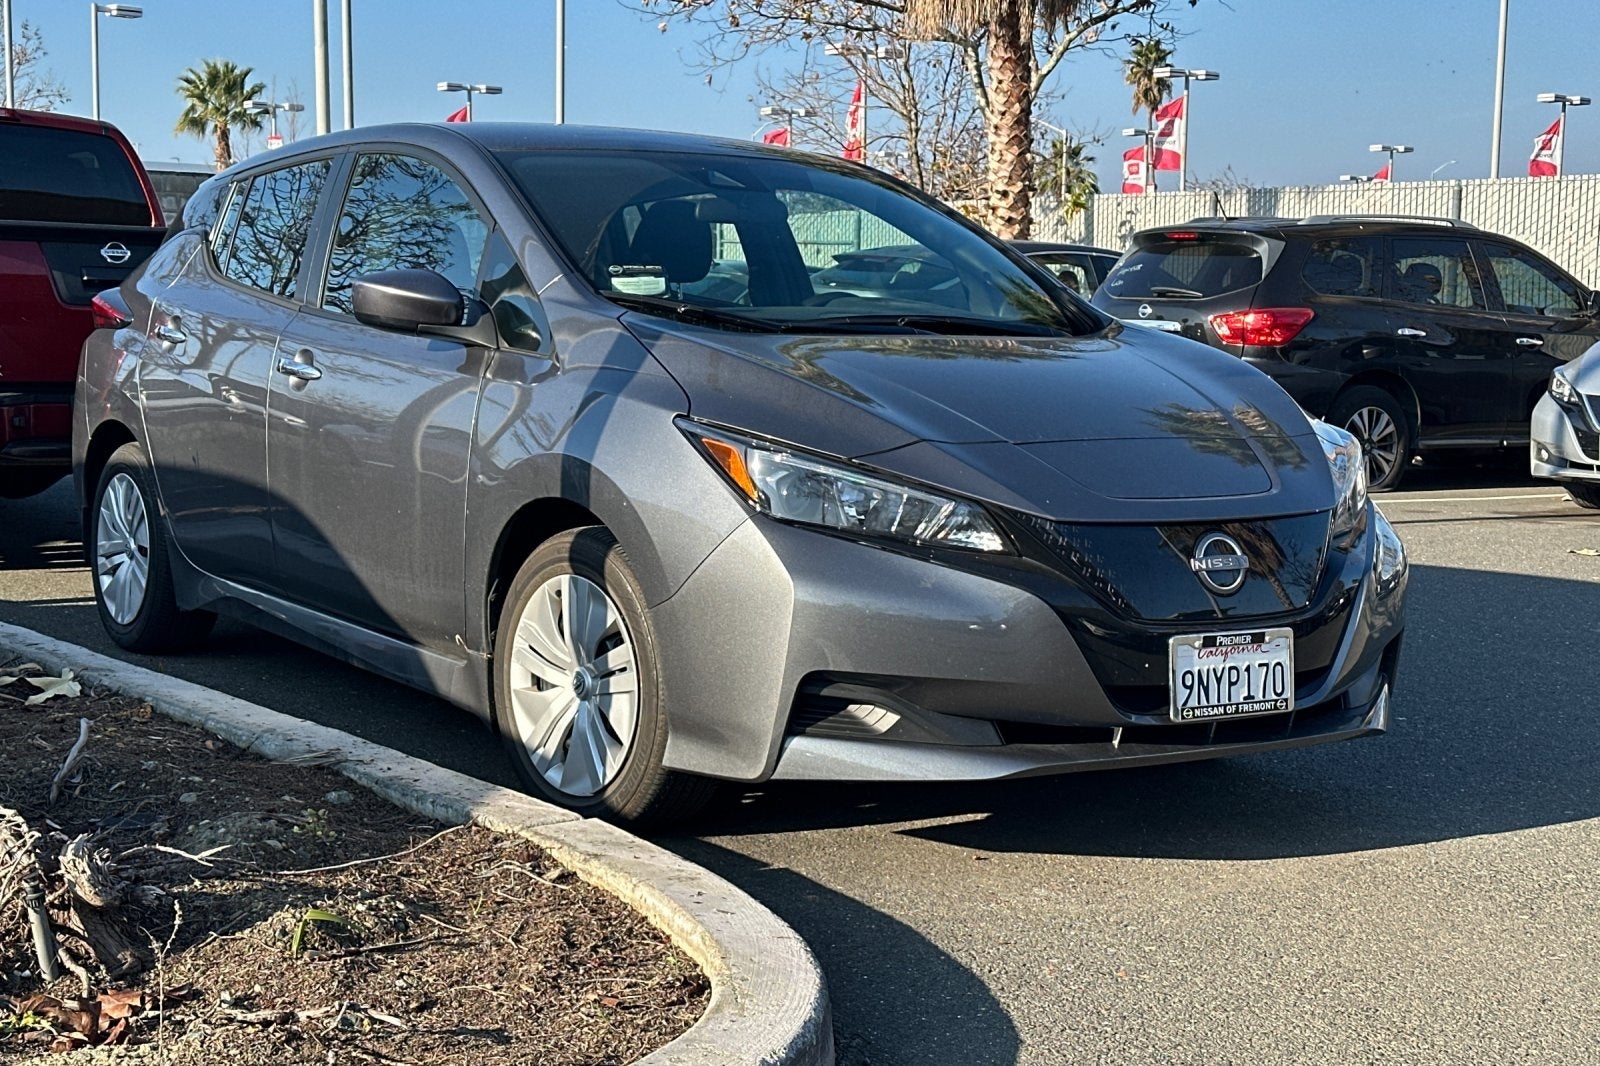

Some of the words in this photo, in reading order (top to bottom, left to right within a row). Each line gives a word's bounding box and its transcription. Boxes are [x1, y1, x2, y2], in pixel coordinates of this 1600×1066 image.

[1216, 635, 1252, 647] PREMIER
[1197, 643, 1269, 662] California
[1181, 661, 1285, 706] 9NYP170
[1194, 704, 1224, 717] NISSAN
[1225, 704, 1237, 714] OF
[1238, 701, 1276, 713] FREMONT
